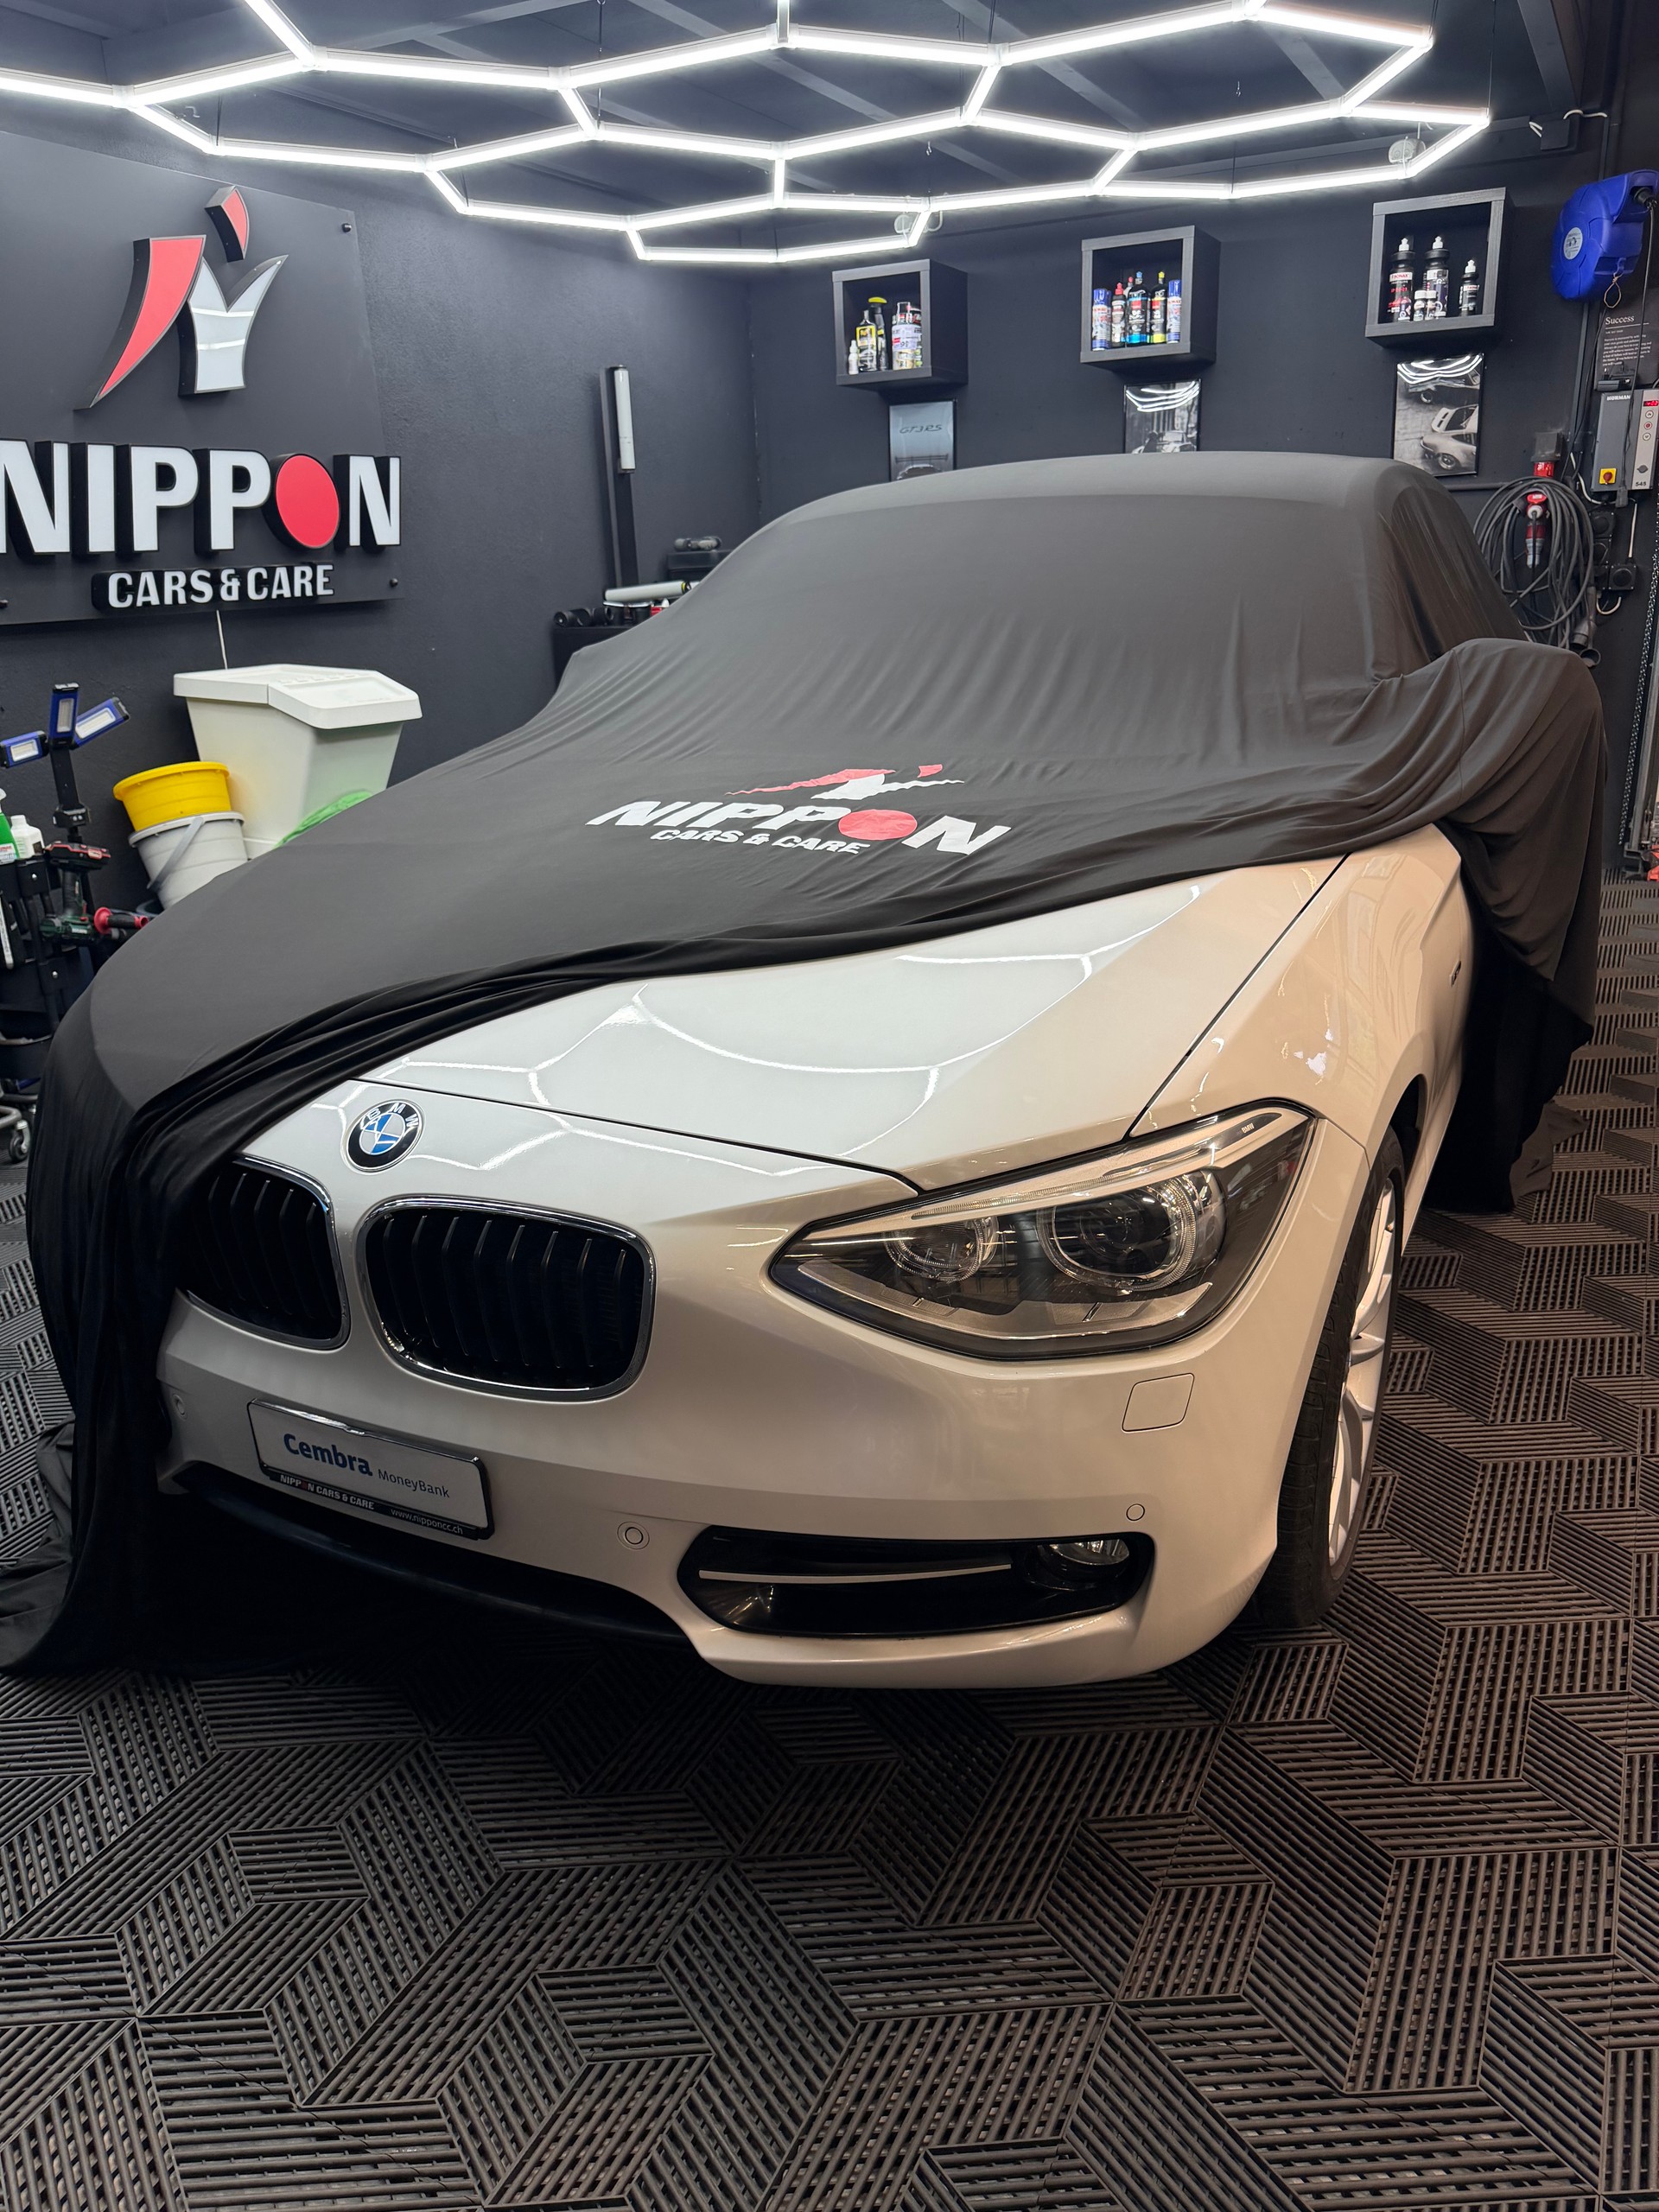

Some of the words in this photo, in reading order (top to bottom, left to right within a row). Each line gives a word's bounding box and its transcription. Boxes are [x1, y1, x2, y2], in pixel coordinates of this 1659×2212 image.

[1605, 315, 1635, 325] Success
[0, 439, 402, 555] NIPPON
[108, 569, 213, 609] CARS
[246, 564, 334, 601] CARE
[585, 800, 1012, 855] NIPPON
[650, 829, 742, 843] CARS
[742, 833, 770, 845] &
[772, 835, 871, 855] CARE
[366, 1103, 419, 1128] BMW
[283, 1433, 373, 1477] Cembra
[378, 1469, 450, 1498] MoneyBank
[315, 1485, 340, 1500] CARS
[341, 1493, 348, 1502] &
[349, 1496, 375, 1510] CARE
[391, 1509, 464, 1535] www.nipponcc.ch
